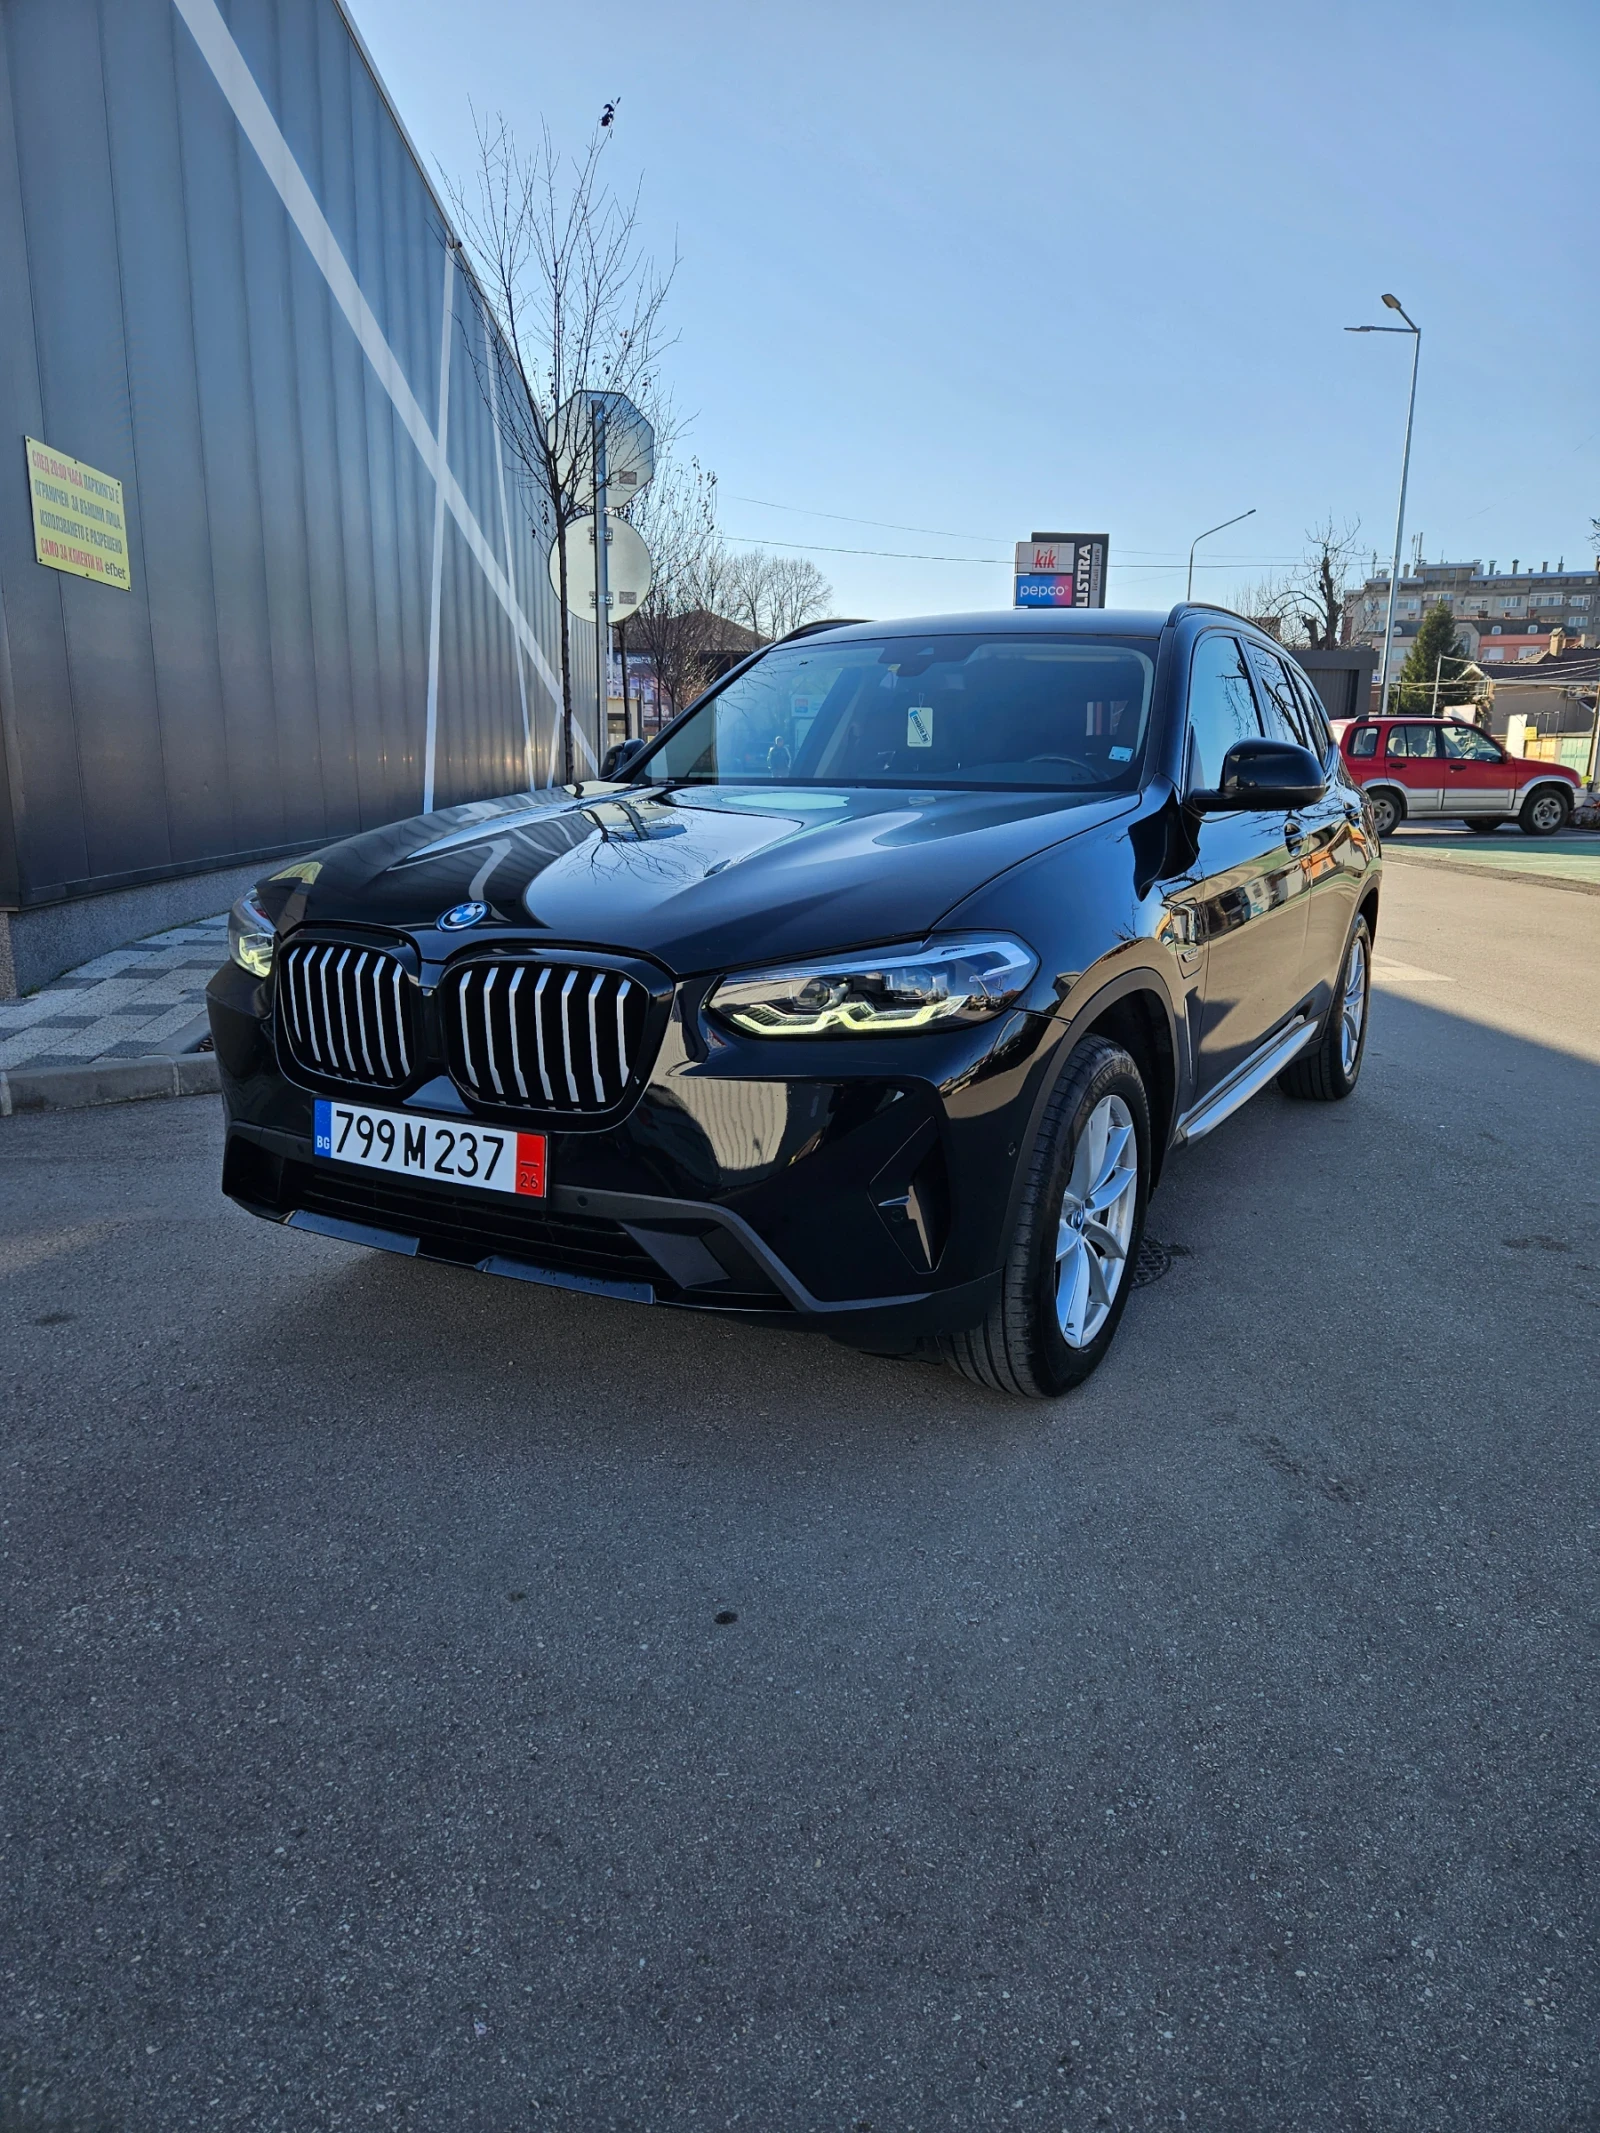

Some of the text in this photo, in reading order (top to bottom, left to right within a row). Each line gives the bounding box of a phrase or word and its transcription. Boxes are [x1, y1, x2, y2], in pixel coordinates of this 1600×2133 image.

[32, 450, 50, 476] СЛЕД
[67, 467, 84, 488] ЧАСА
[35, 479, 69, 509] ОГРАНИЧЕН
[71, 494, 80, 513] ЗА
[40, 537, 59, 558] САМО
[59, 544, 68, 561] ЗА
[95, 557, 104, 573] НА
[104, 561, 126, 580] efbet
[90, 528, 123, 555] РАЗРЕШЕНО
[1020, 585, 1065, 598] pepco
[1075, 544, 1091, 607] LISTRA
[316, 1135, 331, 1150] BG
[336, 1110, 504, 1181] 799 M 237
[520, 1172, 538, 1190] 26
